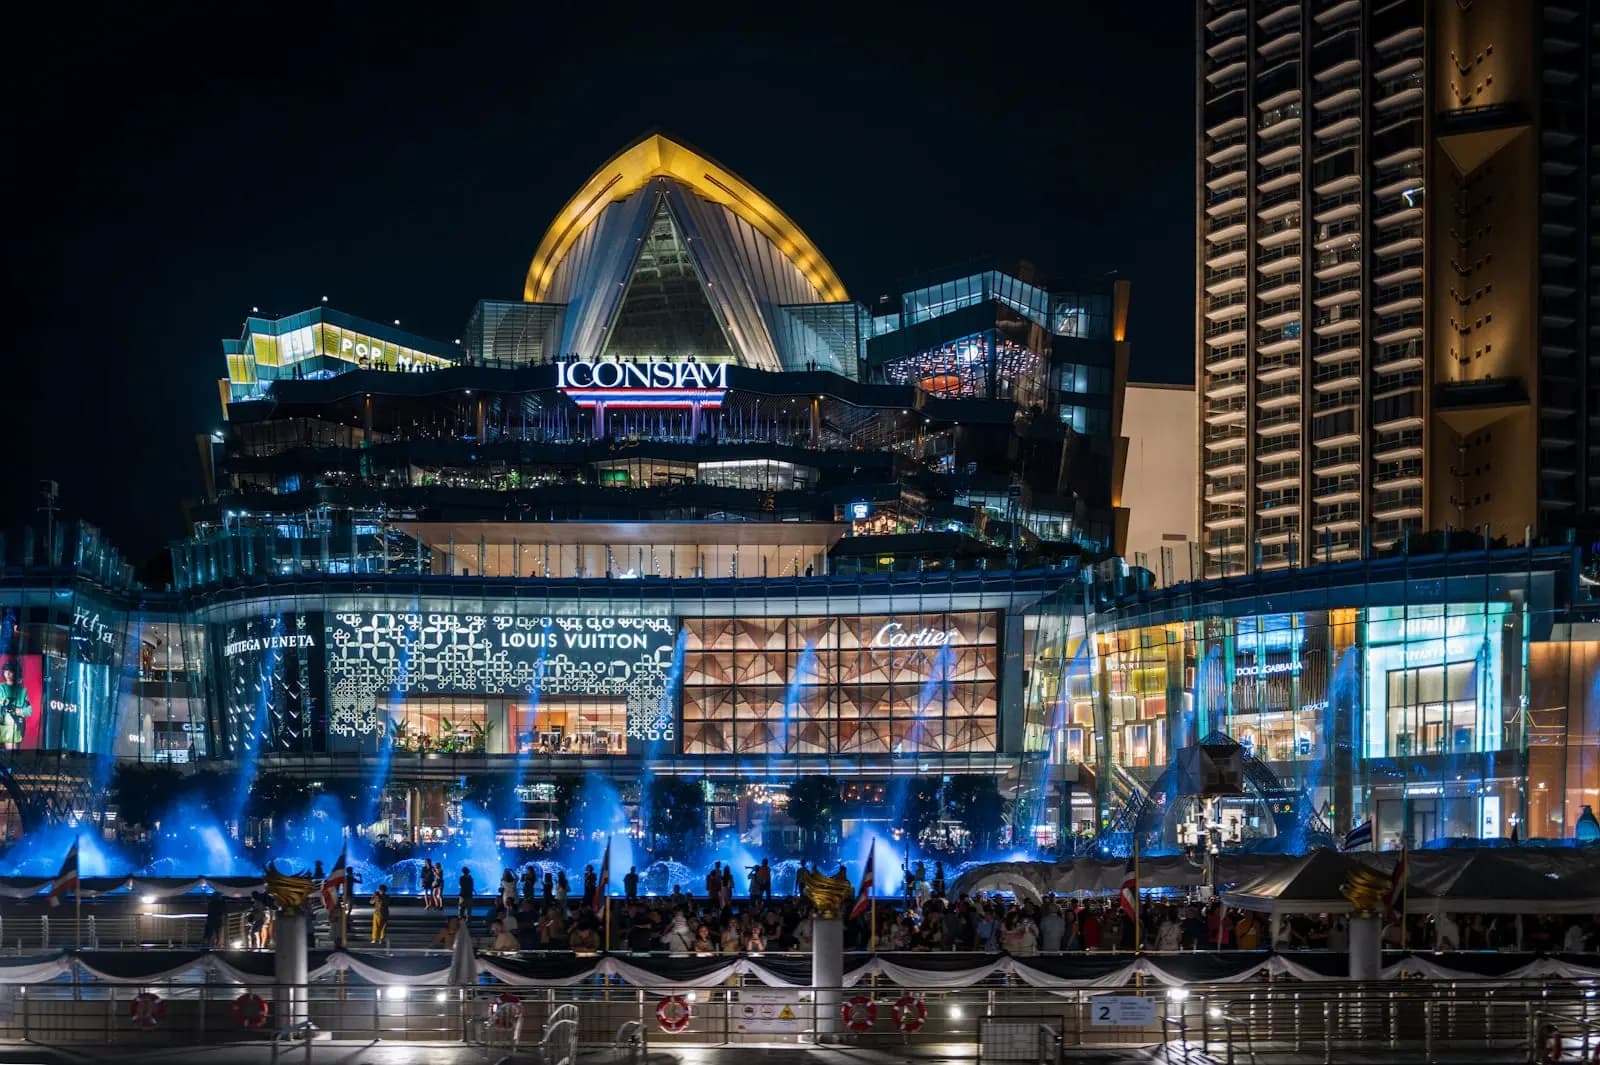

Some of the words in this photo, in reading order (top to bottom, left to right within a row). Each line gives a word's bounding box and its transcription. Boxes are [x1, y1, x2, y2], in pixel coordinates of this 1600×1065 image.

[341, 338, 382, 360] POP
[556, 361, 728, 388] ICONSIAM
[223, 638, 261, 657] BOTTEGA
[262, 634, 316, 649] VENETA
[501, 632, 558, 648] LOUIS
[564, 633, 647, 649] VUITTON
[876, 622, 957, 647] Cartier
[1099, 1006, 1111, 1021] 2
